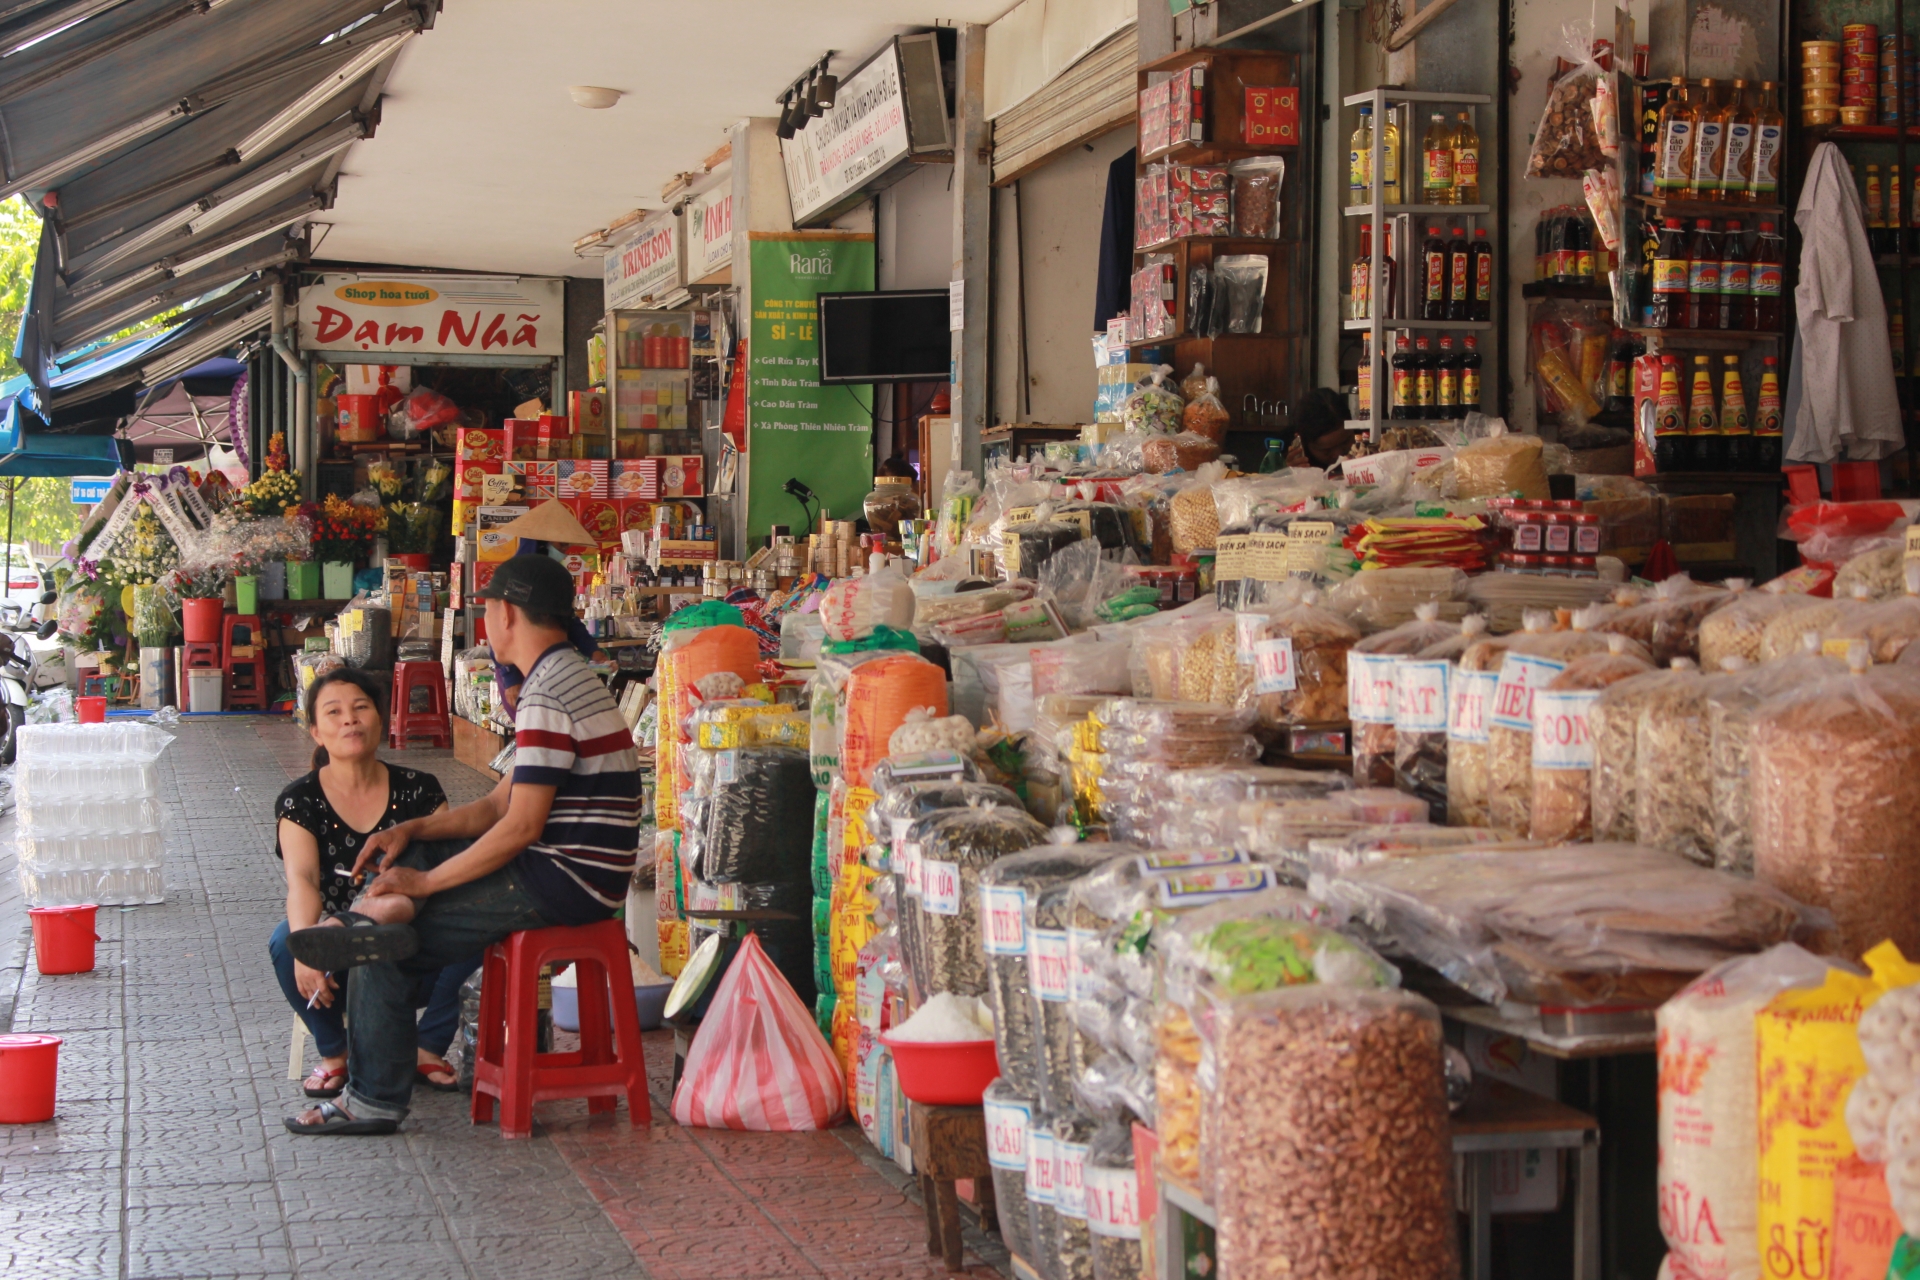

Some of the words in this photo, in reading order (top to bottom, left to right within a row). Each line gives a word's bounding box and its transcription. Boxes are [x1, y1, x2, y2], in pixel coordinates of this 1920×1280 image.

[345, 288, 376, 300] Shop
[380, 289, 402, 300] hoa
[405, 289, 430, 300] tươi
[785, 300, 793, 308] TY
[312, 305, 424, 350] Đạm
[438, 310, 540, 350] Nhã
[772, 322, 786, 340] SỈ
[799, 322, 813, 341] LẺ
[762, 357, 776, 365] Gel
[796, 358, 810, 366] Tay
[762, 378, 778, 386] Tinh
[760, 400, 776, 408] Cao
[798, 400, 818, 409] Tràm
[760, 421, 772, 430] Xà
[774, 422, 798, 432] Phòng
[800, 422, 822, 431] Thiên
[823, 422, 846, 432] Nhiên
[848, 423, 868, 432] Tràm
[488, 478, 508, 486] Coffee
[496, 486, 510, 494] Joy
[184, 487, 202, 512] KÍNH
